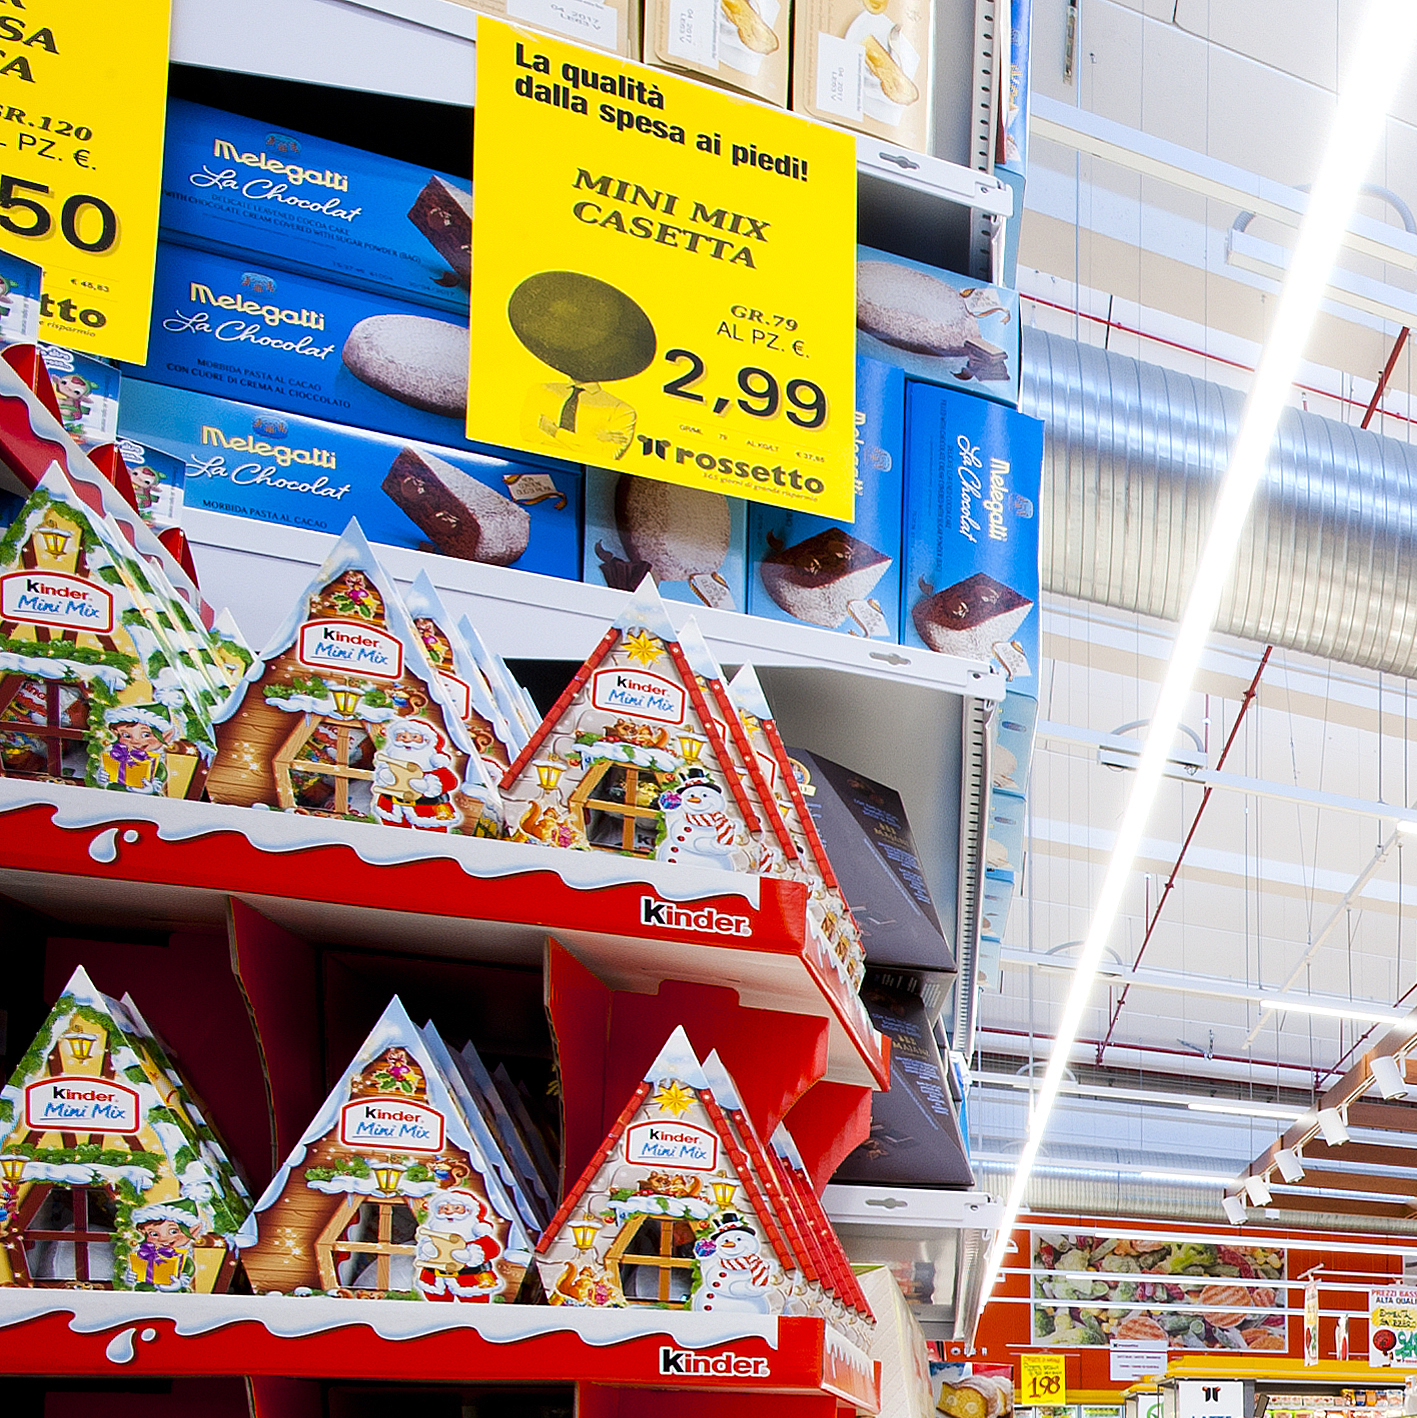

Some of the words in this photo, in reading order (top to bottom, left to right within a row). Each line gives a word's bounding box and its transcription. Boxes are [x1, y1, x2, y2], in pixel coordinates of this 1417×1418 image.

[515, 42, 551, 75] La
[561, 62, 665, 111] qualità
[18, 132, 63, 162] PZ.
[515, 76, 588, 116] dalla
[599, 103, 686, 146] spesa
[696, 132, 721, 157] ai
[731, 143, 809, 183] piedi!
[213, 138, 350, 193] Melegatti
[190, 164, 239, 190] La
[241, 179, 363, 223] Chocolat
[571, 167, 680, 218] MINI
[688, 201, 772, 243] MIX
[188, 195, 241, 218] CHOCOLATE
[242, 209, 272, 224] CREAM
[273, 217, 311, 236] COVERED
[335, 232, 363, 248] SUGAR
[363, 240, 399, 258] POWDER
[211, 193, 252, 211] DELICATE
[296, 214, 327, 230] COCOA
[328, 223, 351, 237] CAKE
[572, 201, 758, 270] CASETTA
[190, 282, 325, 331] Melegatti
[730, 304, 799, 332] GR.79
[162, 309, 212, 334] La
[214, 321, 336, 361] Chocolat
[716, 320, 745, 342] AL
[752, 329, 786, 352] PZ.
[166, 363, 188, 375] CON
[190, 368, 226, 384] CUORE
[226, 375, 238, 386] DI
[239, 378, 274, 395] CREMA
[275, 386, 287, 396] AL
[288, 388, 352, 409] CIOCCOLATO
[197, 358, 242, 375] MORBIDA
[243, 368, 274, 384] PASTA
[275, 375, 287, 386] AL
[287, 378, 322, 393] CACAO
[663, 348, 828, 430] 2,99
[201, 425, 338, 470] Melegatti
[957, 434, 983, 468] La
[185, 453, 229, 478] La
[229, 463, 353, 501] Chocolat
[675, 447, 826, 495] rossetto
[202, 499, 248, 516] MORBIDA
[249, 507, 280, 522] PASTA
[280, 513, 293, 524] AL
[293, 516, 328, 529] CACAO
[957, 465, 983, 544] Chocolat
[983, 457, 1011, 542] Melegatti
[26, 578, 90, 600] Kinder
[18, 595, 62, 614] Mini
[64, 599, 100, 619] Mix
[315, 642, 355, 660] Mini
[356, 649, 389, 666] Mix
[323, 627, 379, 648] Kinder
[608, 689, 645, 707] Mini
[646, 693, 675, 713] Mix
[617, 675, 668, 697] Kinder
[642, 897, 750, 935] Kinder
[44, 1102, 88, 1119] Mini
[90, 1103, 127, 1120] Mix
[53, 1086, 117, 1103] Kinder
[356, 1121, 397, 1137] Mini
[398, 1123, 430, 1139] Mix
[640, 1142, 677, 1158] Mini
[678, 1144, 707, 1160] Mix
[1371, 1289, 1397, 1297] PREZZI
[1376, 1297, 1393, 1305] ALTA
[662, 1347, 768, 1377] Kinder
